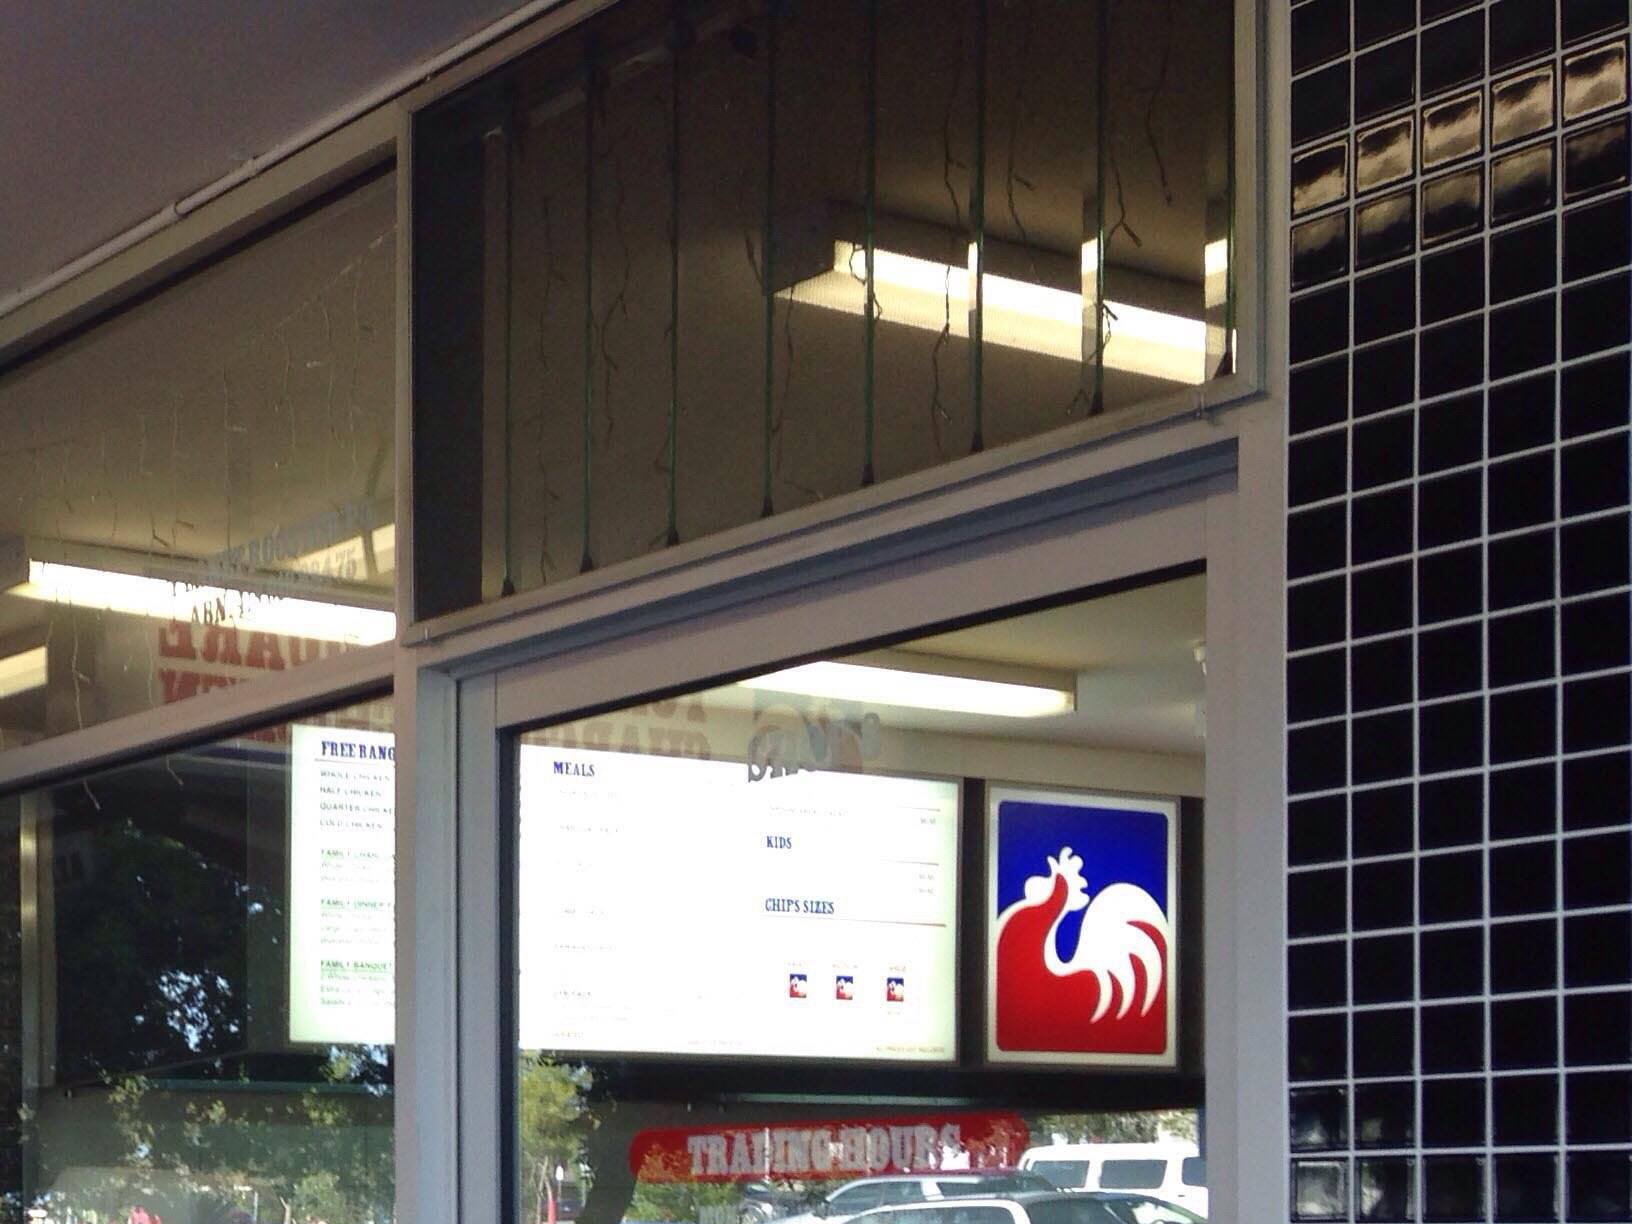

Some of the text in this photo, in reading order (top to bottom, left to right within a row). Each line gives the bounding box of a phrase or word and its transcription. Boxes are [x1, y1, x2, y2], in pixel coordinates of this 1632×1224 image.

[321, 740, 356, 758] FREE
[553, 760, 596, 777] MEALS
[766, 835, 793, 850] KIDS
[765, 897, 835, 915] CHIPS SIZES
